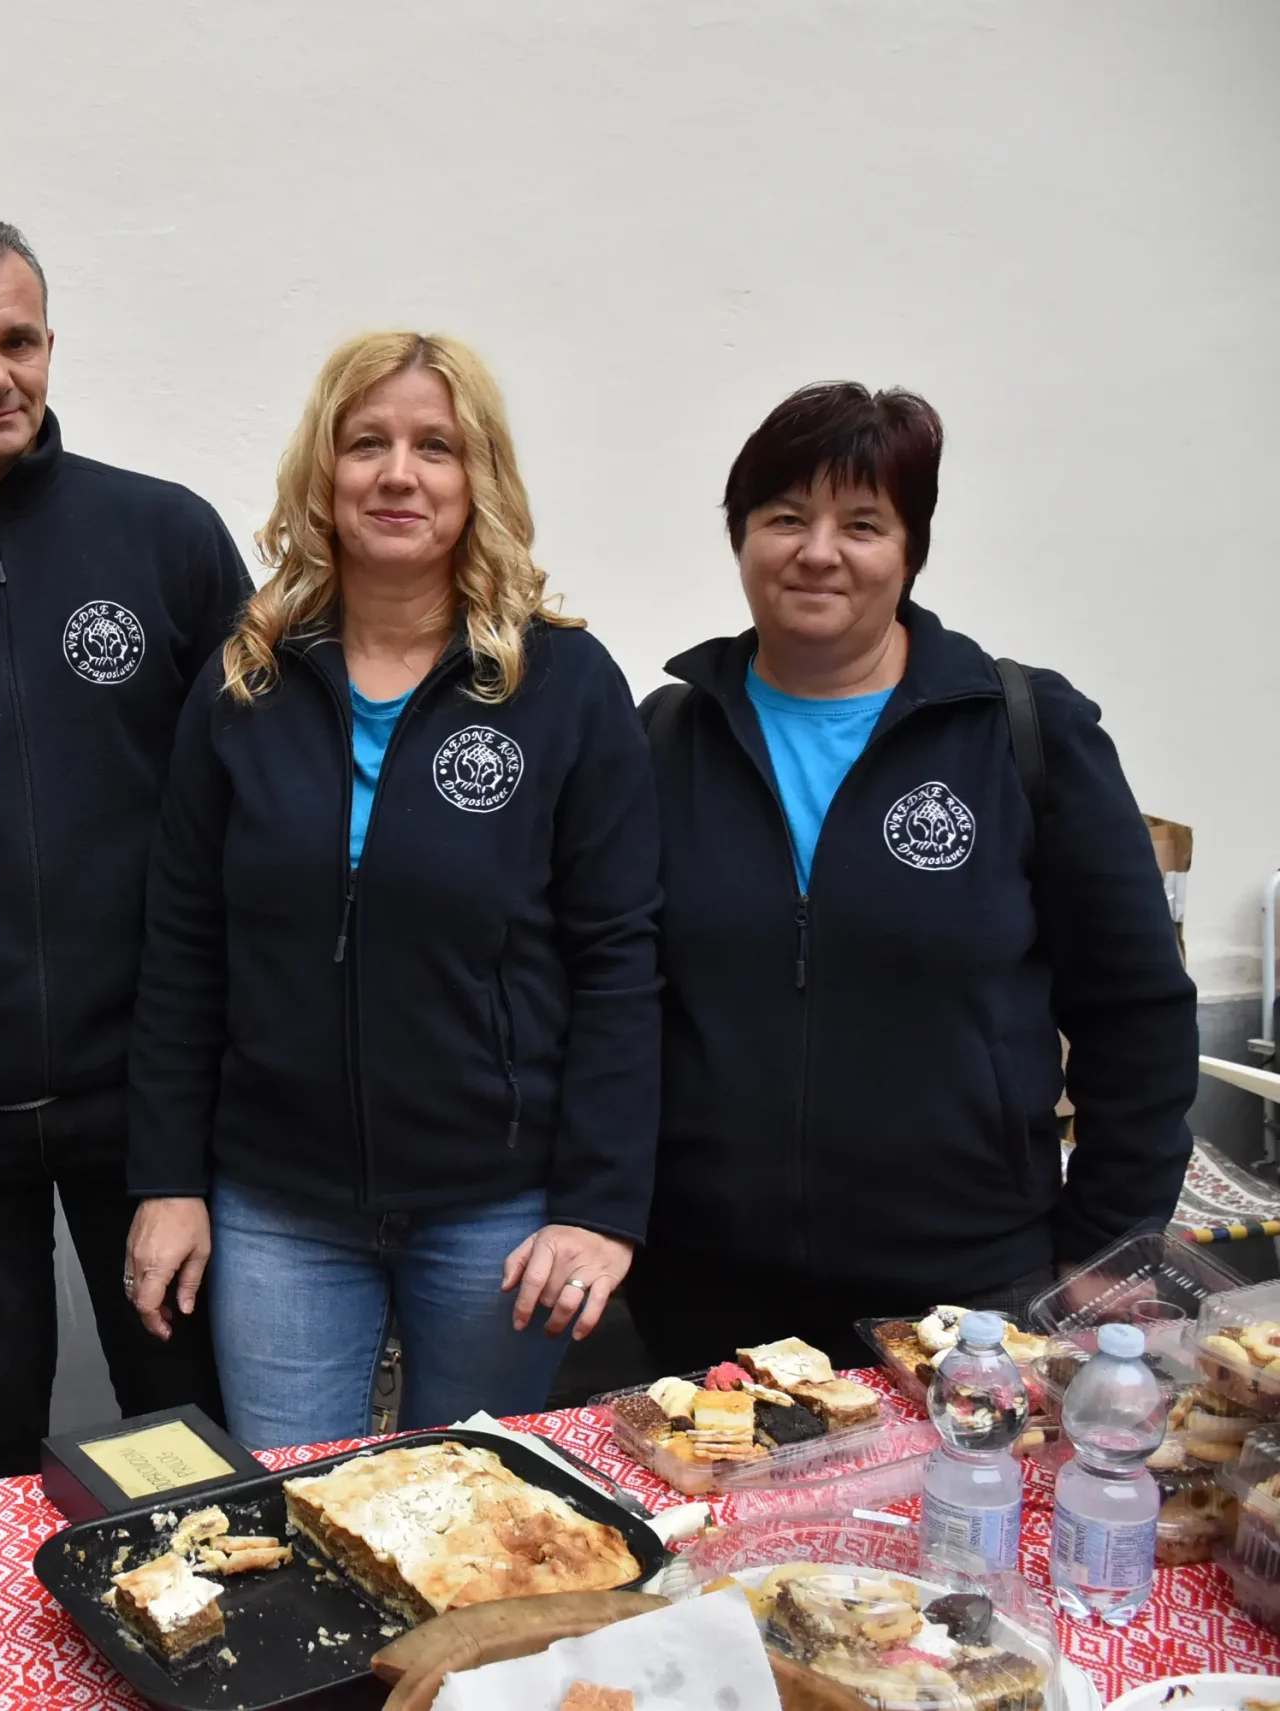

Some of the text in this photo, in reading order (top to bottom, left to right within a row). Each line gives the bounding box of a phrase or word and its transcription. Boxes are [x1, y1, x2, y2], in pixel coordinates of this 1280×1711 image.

[66, 604, 109, 650] VREDNE
[437, 730, 519, 773] VREDNE ROKE
[441, 780, 508, 807] Dragoslavec
[888, 786, 972, 832] VREDNE ROKE
[896, 842, 966, 867] Dragoslavec
